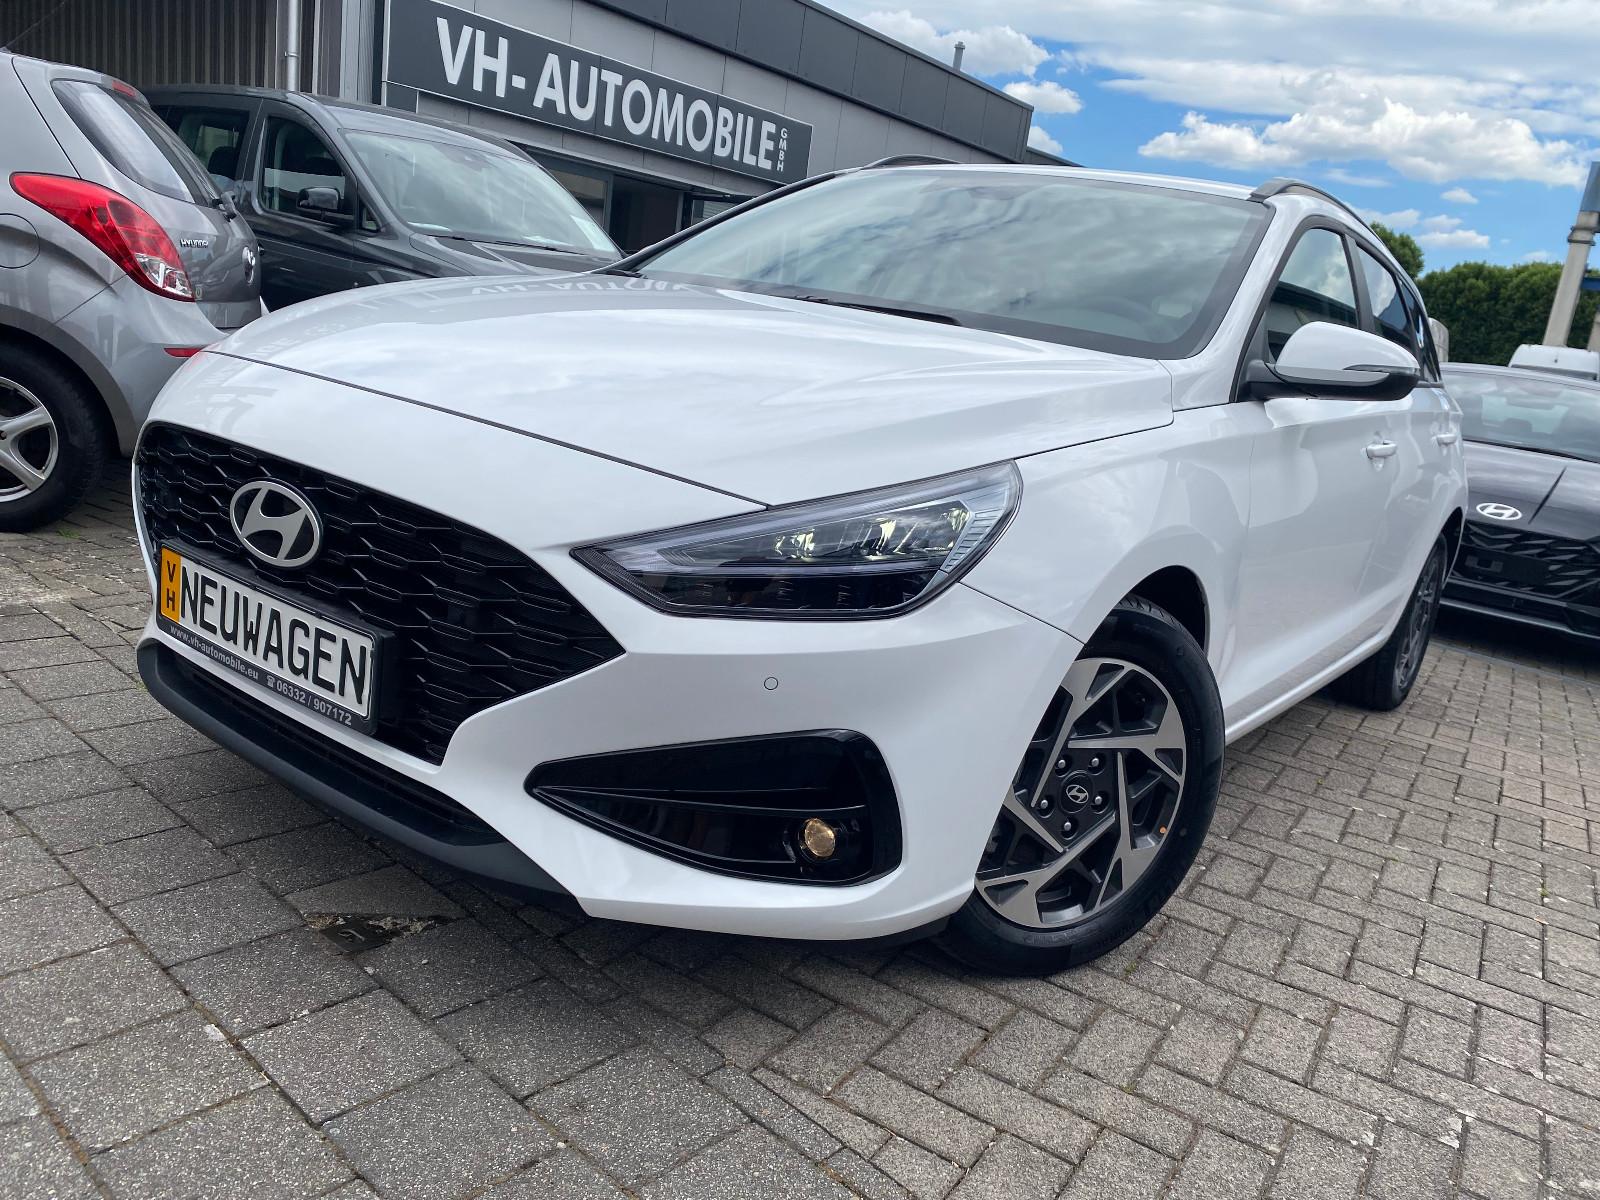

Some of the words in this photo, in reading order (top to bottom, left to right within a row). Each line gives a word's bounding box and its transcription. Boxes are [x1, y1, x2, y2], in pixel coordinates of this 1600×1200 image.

[170, 625, 259, 680] www.vh-automobile.eu
[276, 680, 306, 704] 06332
[313, 698, 352, 726] 907172
[180, 565, 367, 705] NEUWAGEN
